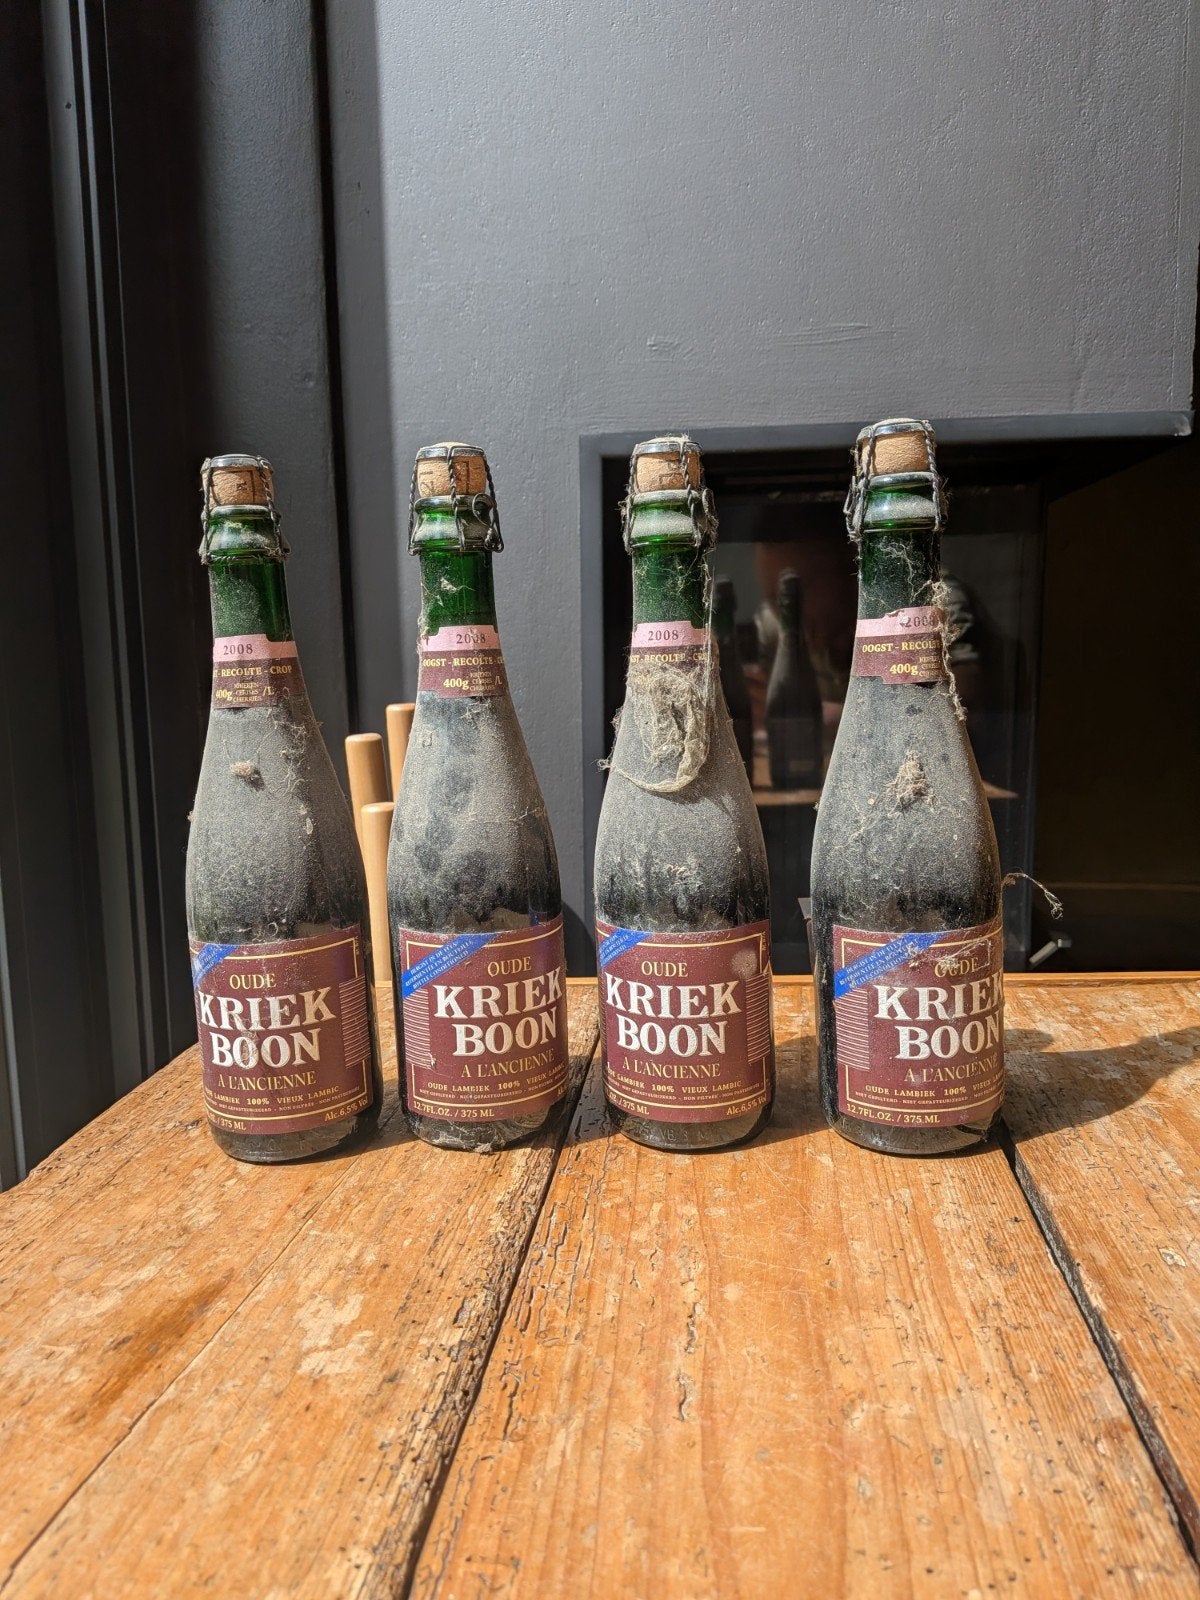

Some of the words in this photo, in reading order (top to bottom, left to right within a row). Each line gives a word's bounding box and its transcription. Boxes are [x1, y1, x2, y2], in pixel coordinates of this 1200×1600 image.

[456, 632, 486, 644] 2008
[648, 630, 679, 640] 2008
[223, 643, 253, 655] 2008
[862, 643, 894, 653] OOGST
[453, 656, 493, 667] RECOLTE
[644, 653, 686, 662] RECOLTE
[222, 667, 262, 677] RECOLTE
[269, 665, 292, 674] CROP
[889, 663, 919, 676] 400g
[443, 678, 470, 690] 400g
[487, 956, 532, 977] OUDE
[641, 960, 689, 978] OUDE
[229, 973, 277, 990] OUDE
[432, 966, 563, 1019] KRIEK
[605, 971, 742, 1019] KRIEK
[198, 986, 337, 1031] KRIEK
[452, 1006, 557, 1057] BOON
[616, 1013, 728, 1058] BOON
[894, 1010, 1000, 1060] BOON
[209, 1027, 322, 1070] BOON
[461, 1064, 471, 1078] A
[477, 1049, 555, 1078] L'ANCIENNE
[622, 1056, 630, 1071] A
[634, 1060, 721, 1080] L'ANCIENNE
[218, 1073, 226, 1088] A
[228, 1070, 317, 1091] L'ANCIENNE
[904, 1068, 915, 1082] A
[427, 1082, 448, 1091] OUDE
[498, 1080, 520, 1090] 100%
[651, 1084, 675, 1093] 100%
[681, 1086, 708, 1094] VIEUX
[712, 1080, 742, 1092] LAMBIC
[865, 1085, 890, 1095] OUDE
[894, 1089, 936, 1098] LAMBIEK
[943, 1086, 967, 1096] 100%
[246, 1097, 270, 1105] 100%
[276, 1094, 304, 1104] VIEUX
[308, 1086, 339, 1099] LAMBIC
[461, 1109, 478, 1118] 375
[480, 1109, 495, 1117] ML
[622, 1100, 635, 1111] 375
[636, 1104, 650, 1115] ML
[233, 1121, 247, 1130] ML
[903, 1114, 922, 1123] 375
[924, 1114, 940, 1123] ML
